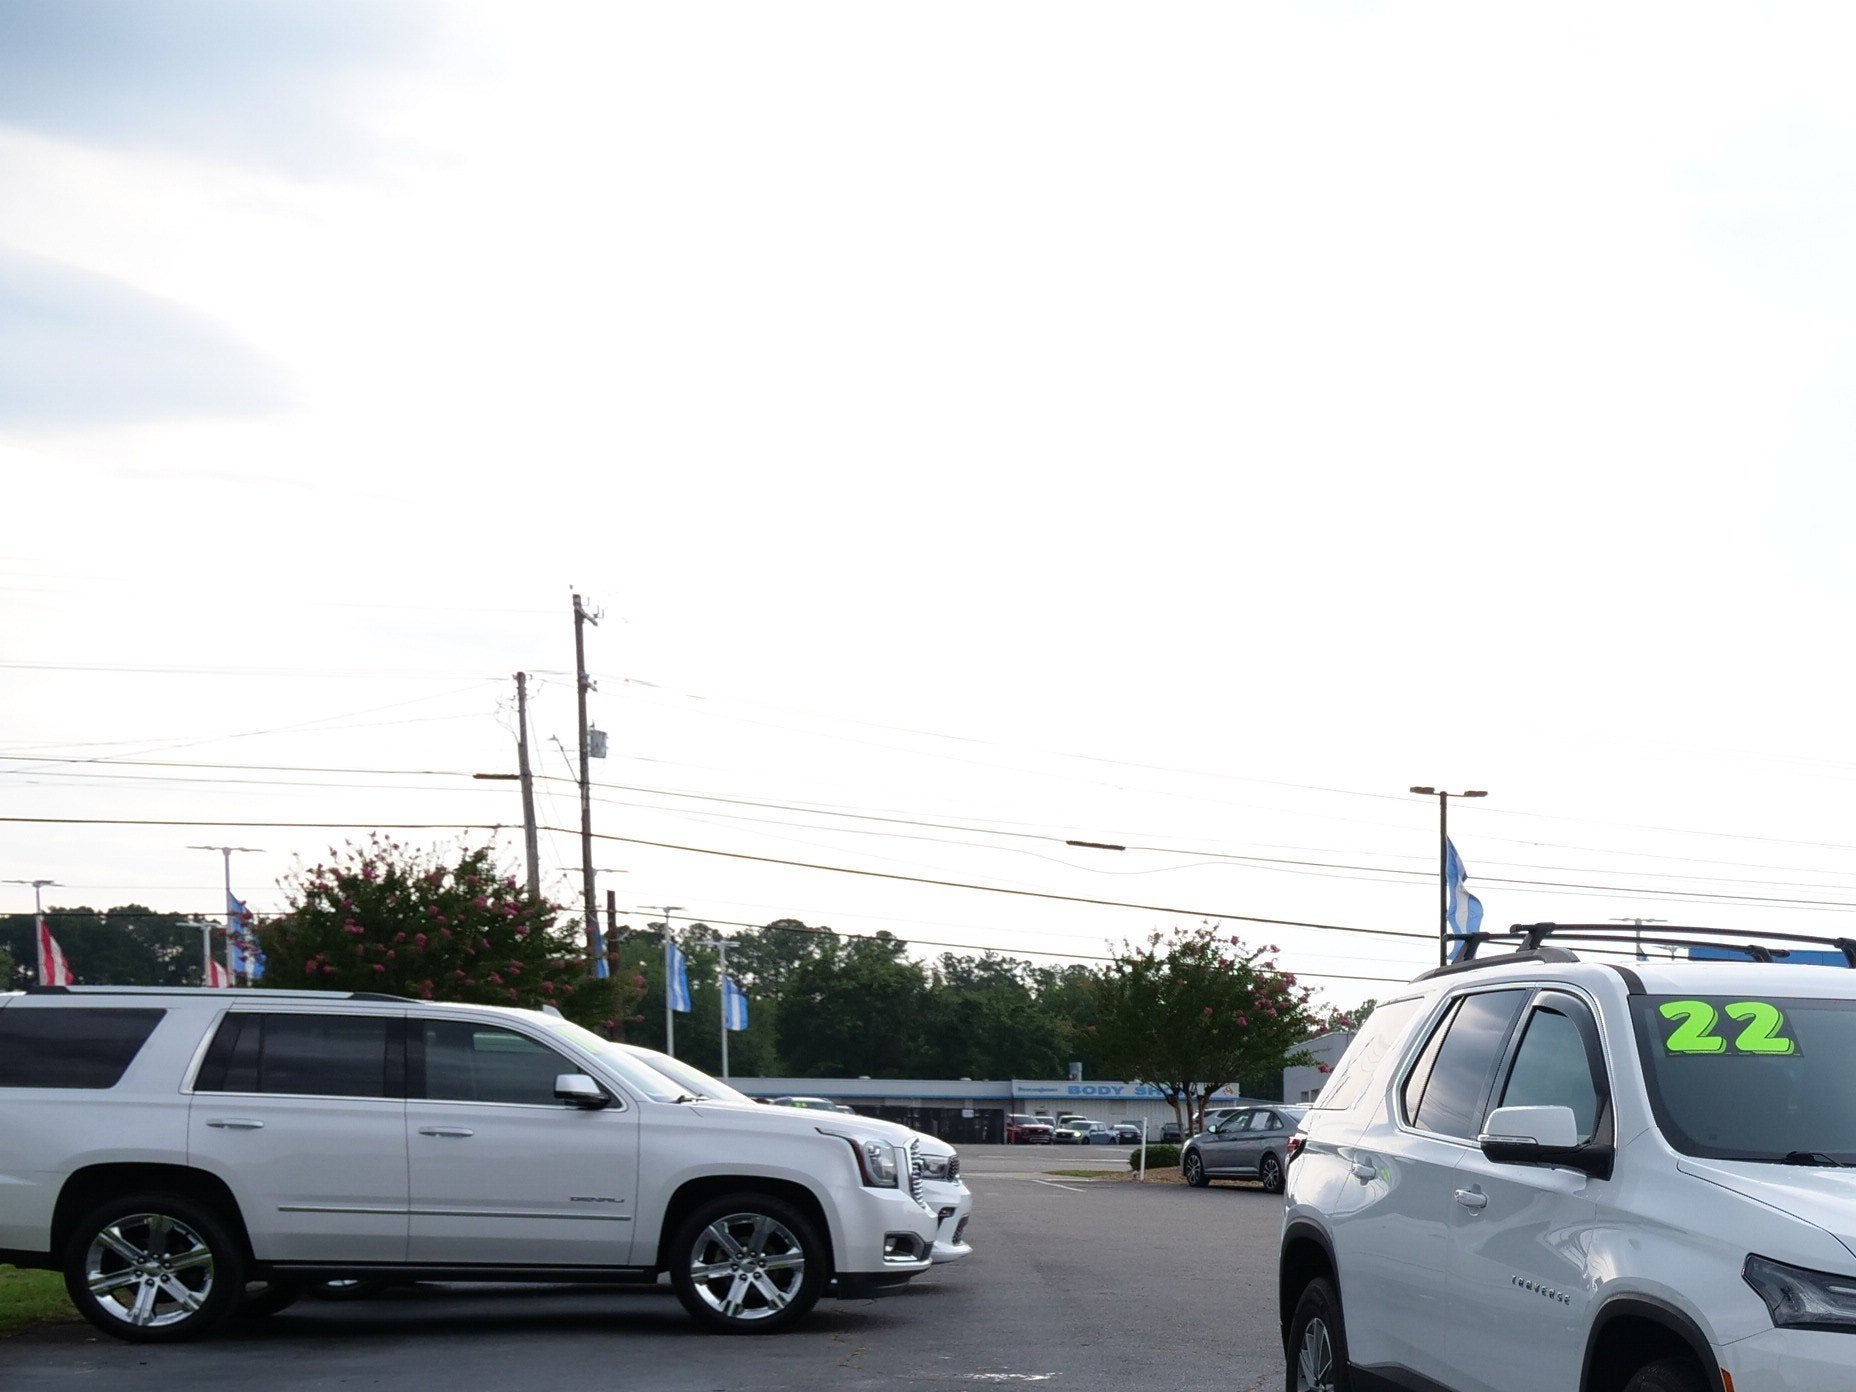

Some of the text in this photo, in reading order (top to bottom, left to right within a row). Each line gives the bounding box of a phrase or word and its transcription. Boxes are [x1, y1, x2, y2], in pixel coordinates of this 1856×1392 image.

[1659, 1000, 1795, 1055] 22
[1067, 1086, 1124, 1095] BODY
[1511, 1274, 1571, 1306] TRAVERSE
